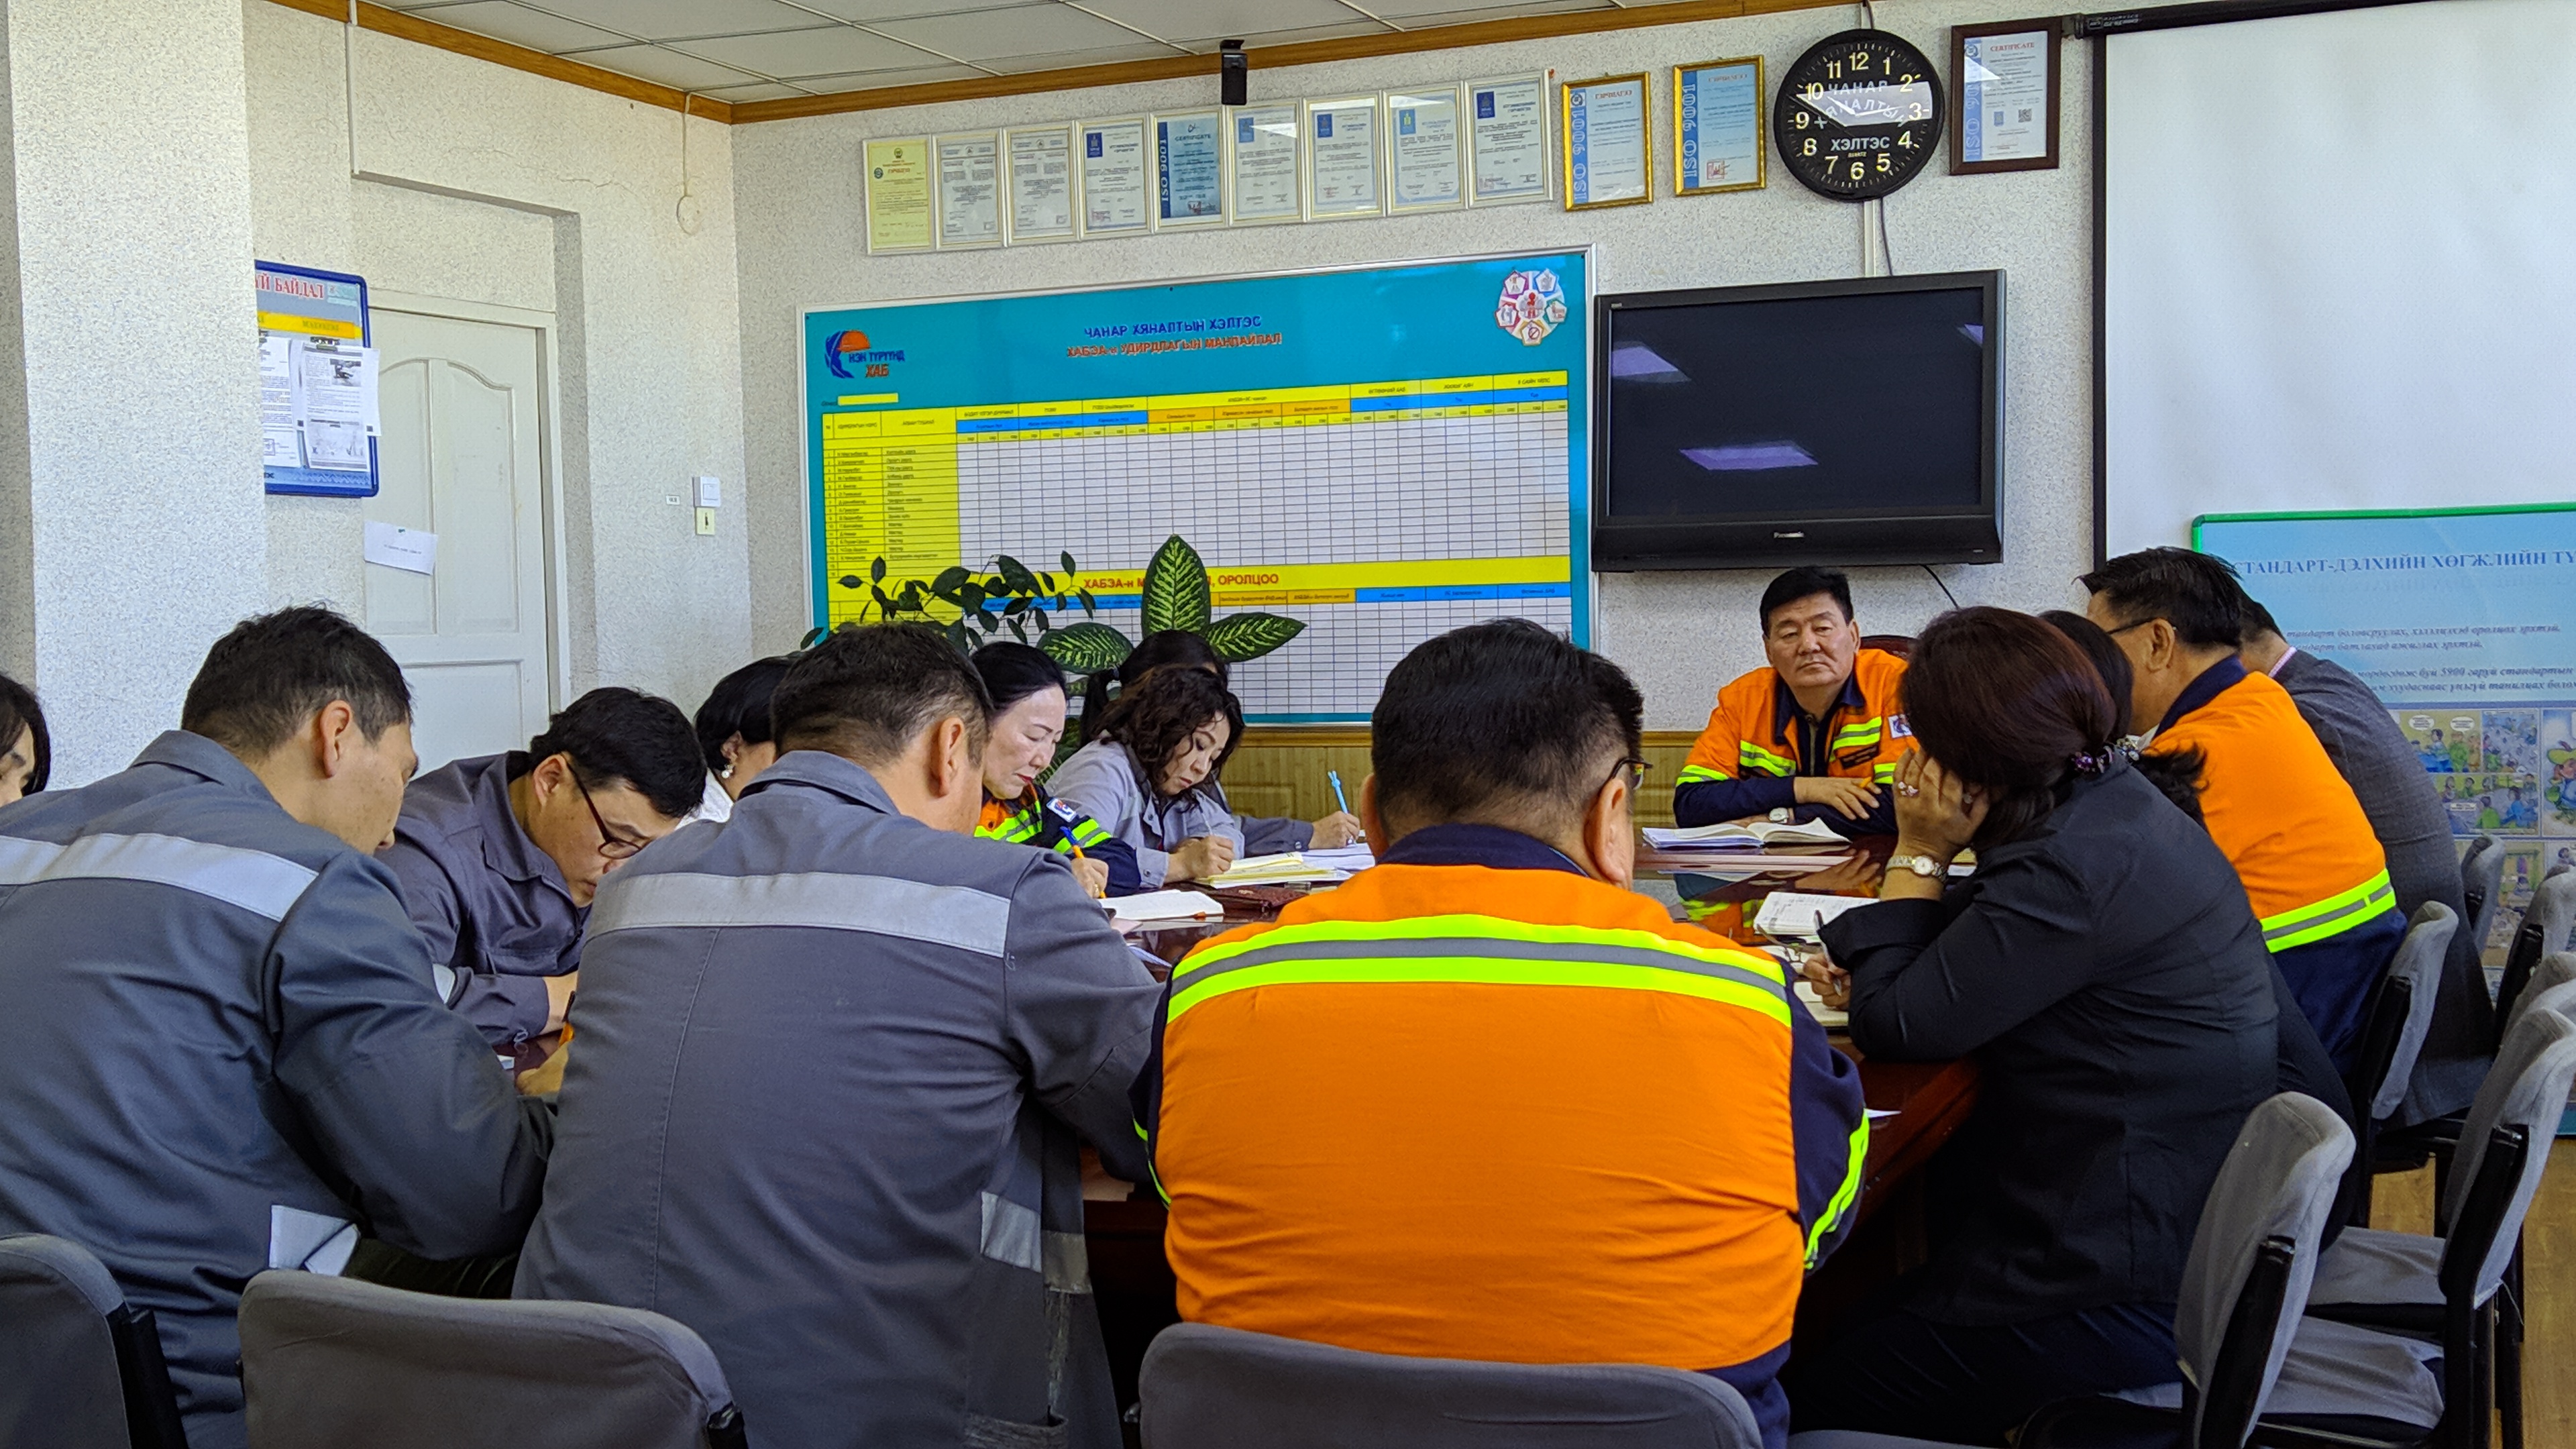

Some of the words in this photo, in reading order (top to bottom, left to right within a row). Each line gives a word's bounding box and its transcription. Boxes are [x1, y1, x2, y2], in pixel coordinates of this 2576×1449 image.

[1826, 60, 1841, 79] 11
[1849, 52, 1869, 71] 12
[1882, 56, 1890, 75] 1
[1805, 82, 1824, 101] 10
[1828, 80, 1888, 95] ЧАНАР
[1900, 74, 1913, 93] 2
[1682, 84, 1696, 131] 9001
[1909, 102, 1922, 121] 3
[1795, 111, 1810, 129] 9
[1572, 109, 1585, 156] 9001
[1897, 130, 1913, 149] 4
[1966, 117, 1980, 156] ISO
[1803, 138, 1817, 156] 8
[1830, 136, 1890, 151] ХЭЛТЭС
[1684, 140, 1697, 178] ISO
[1825, 155, 1839, 174] 7
[1876, 152, 1890, 172] 5
[1850, 162, 1864, 180] 6
[1161, 178, 1169, 201] ISO
[1573, 164, 1587, 200] ISO
[275, 277, 323, 299] БАЙДАЛ
[1084, 325, 1128, 338] ЧАНАР
[1133, 319, 1205, 335] ХЯНАЛТЫН
[1210, 316, 1262, 330] ХЭЛТЭС
[1120, 337, 1203, 354] УДИРДЛАГЫН
[849, 353, 867, 363] НЭН
[865, 364, 890, 378] ХАБ
[2432, 549, 2546, 568] ХӨГЖЛИЙН
[1083, 578, 1134, 589] ХАБЭА-н
[1218, 574, 1279, 587] ОРОЛЦОО
[2286, 629, 2334, 639] тандарт
